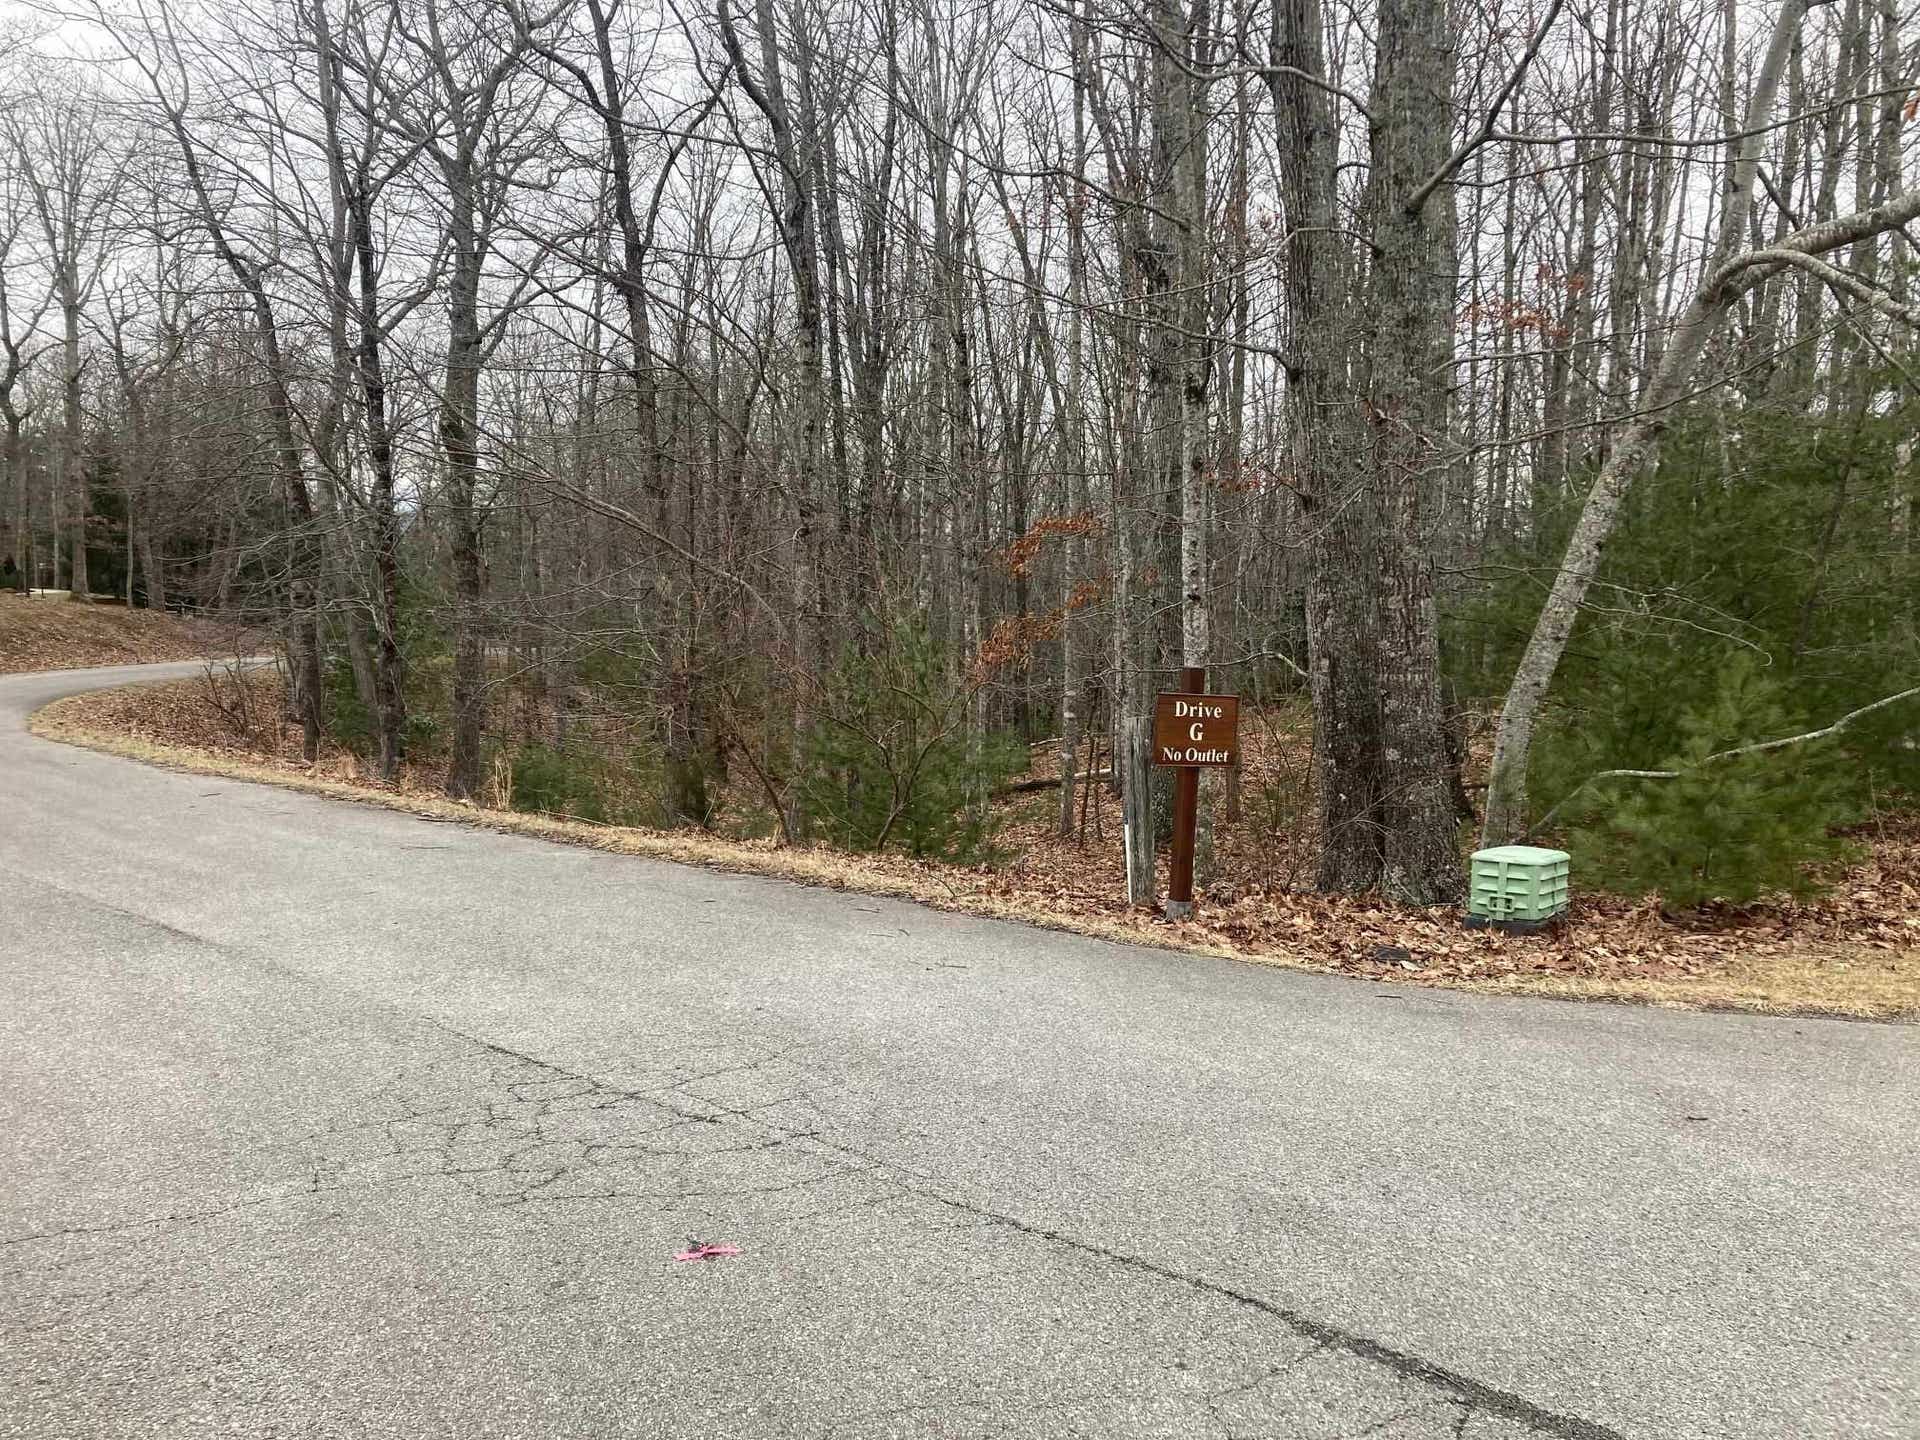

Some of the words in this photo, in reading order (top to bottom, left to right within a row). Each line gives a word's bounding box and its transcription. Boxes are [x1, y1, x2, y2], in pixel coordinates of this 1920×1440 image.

[1175, 701, 1222, 718] Drive
[1189, 722, 1204, 741] G
[1162, 747, 1182, 761] No
[1185, 747, 1229, 762] Outlet
